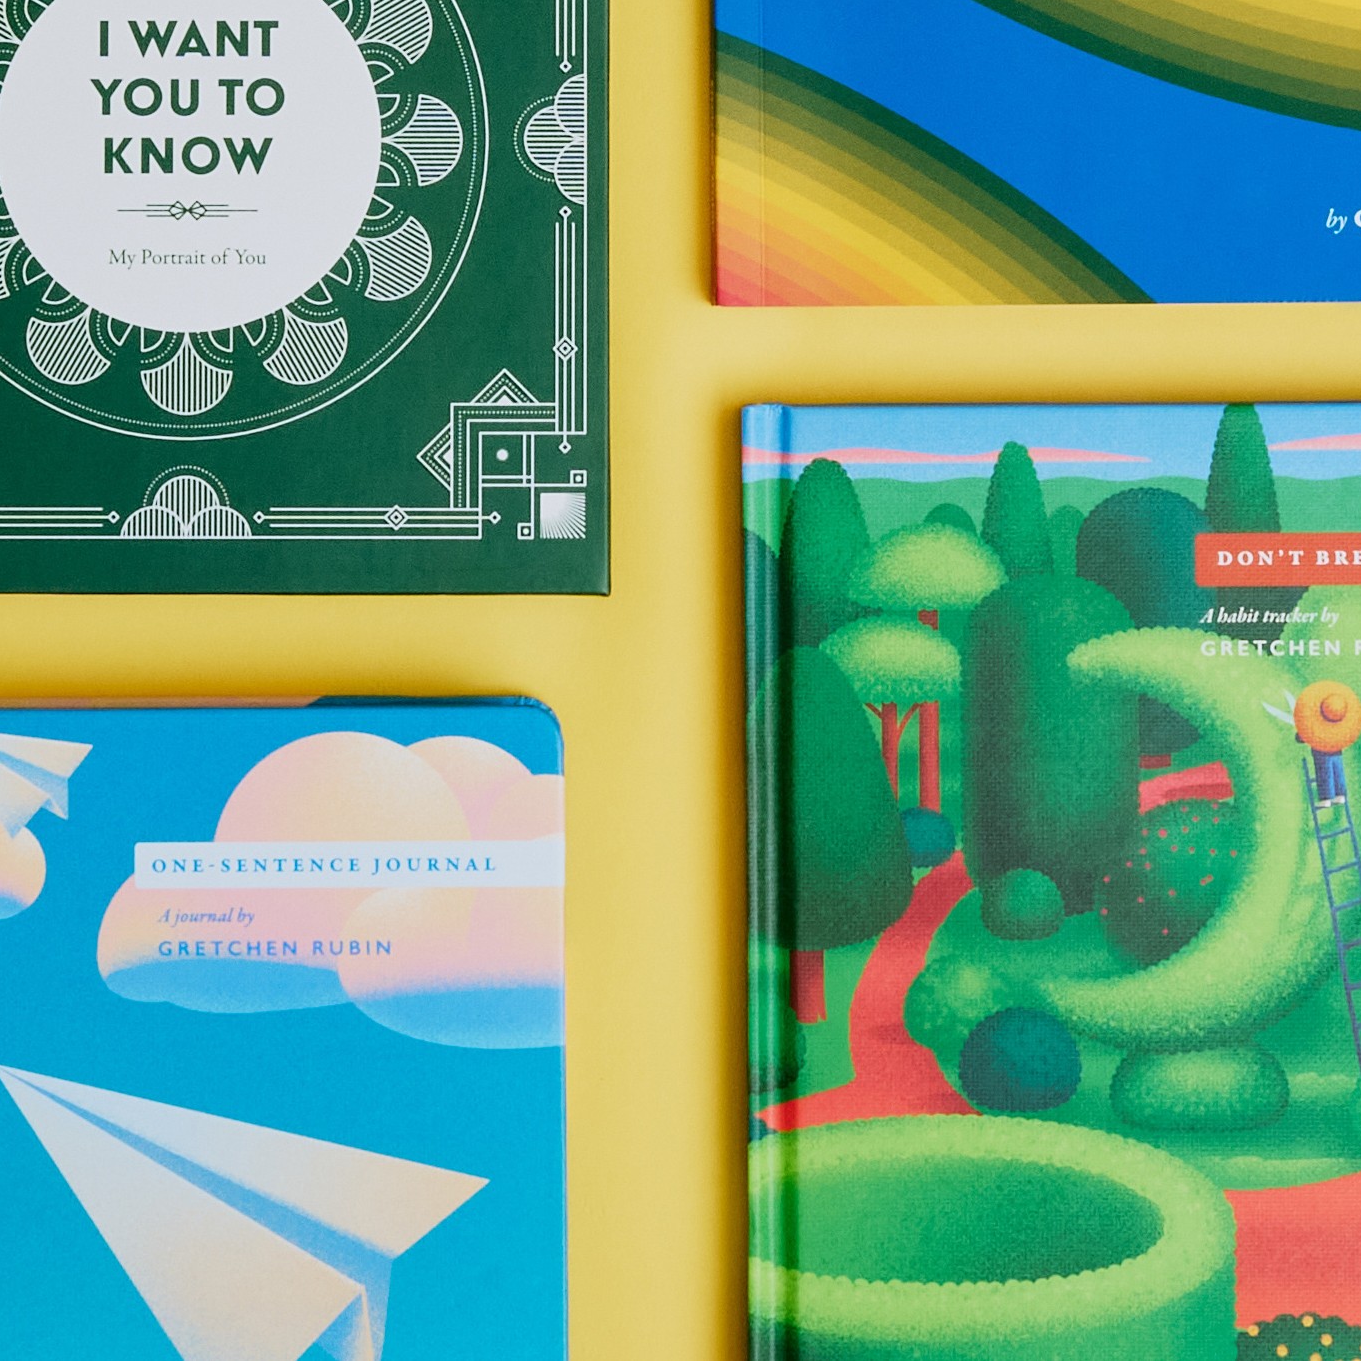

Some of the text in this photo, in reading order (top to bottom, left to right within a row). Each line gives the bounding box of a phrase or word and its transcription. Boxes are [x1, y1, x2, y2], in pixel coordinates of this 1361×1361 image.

[100, 20, 278, 57] I WANT
[91, 78, 284, 116] YOU TO
[105, 137, 272, 174] KNOW
[1326, 208, 1347, 234] by
[110, 248, 265, 269] My Portrait of You
[1218, 550, 1304, 565] DON'T
[1199, 606, 1340, 627] A habit tracker by
[1201, 640, 1340, 657] GRETCHEN
[152, 858, 496, 875] ONE-SENTENCE JOURNAL
[159, 907, 254, 927] A journal by
[158, 940, 390, 957] GRETCHEN RUBIN
